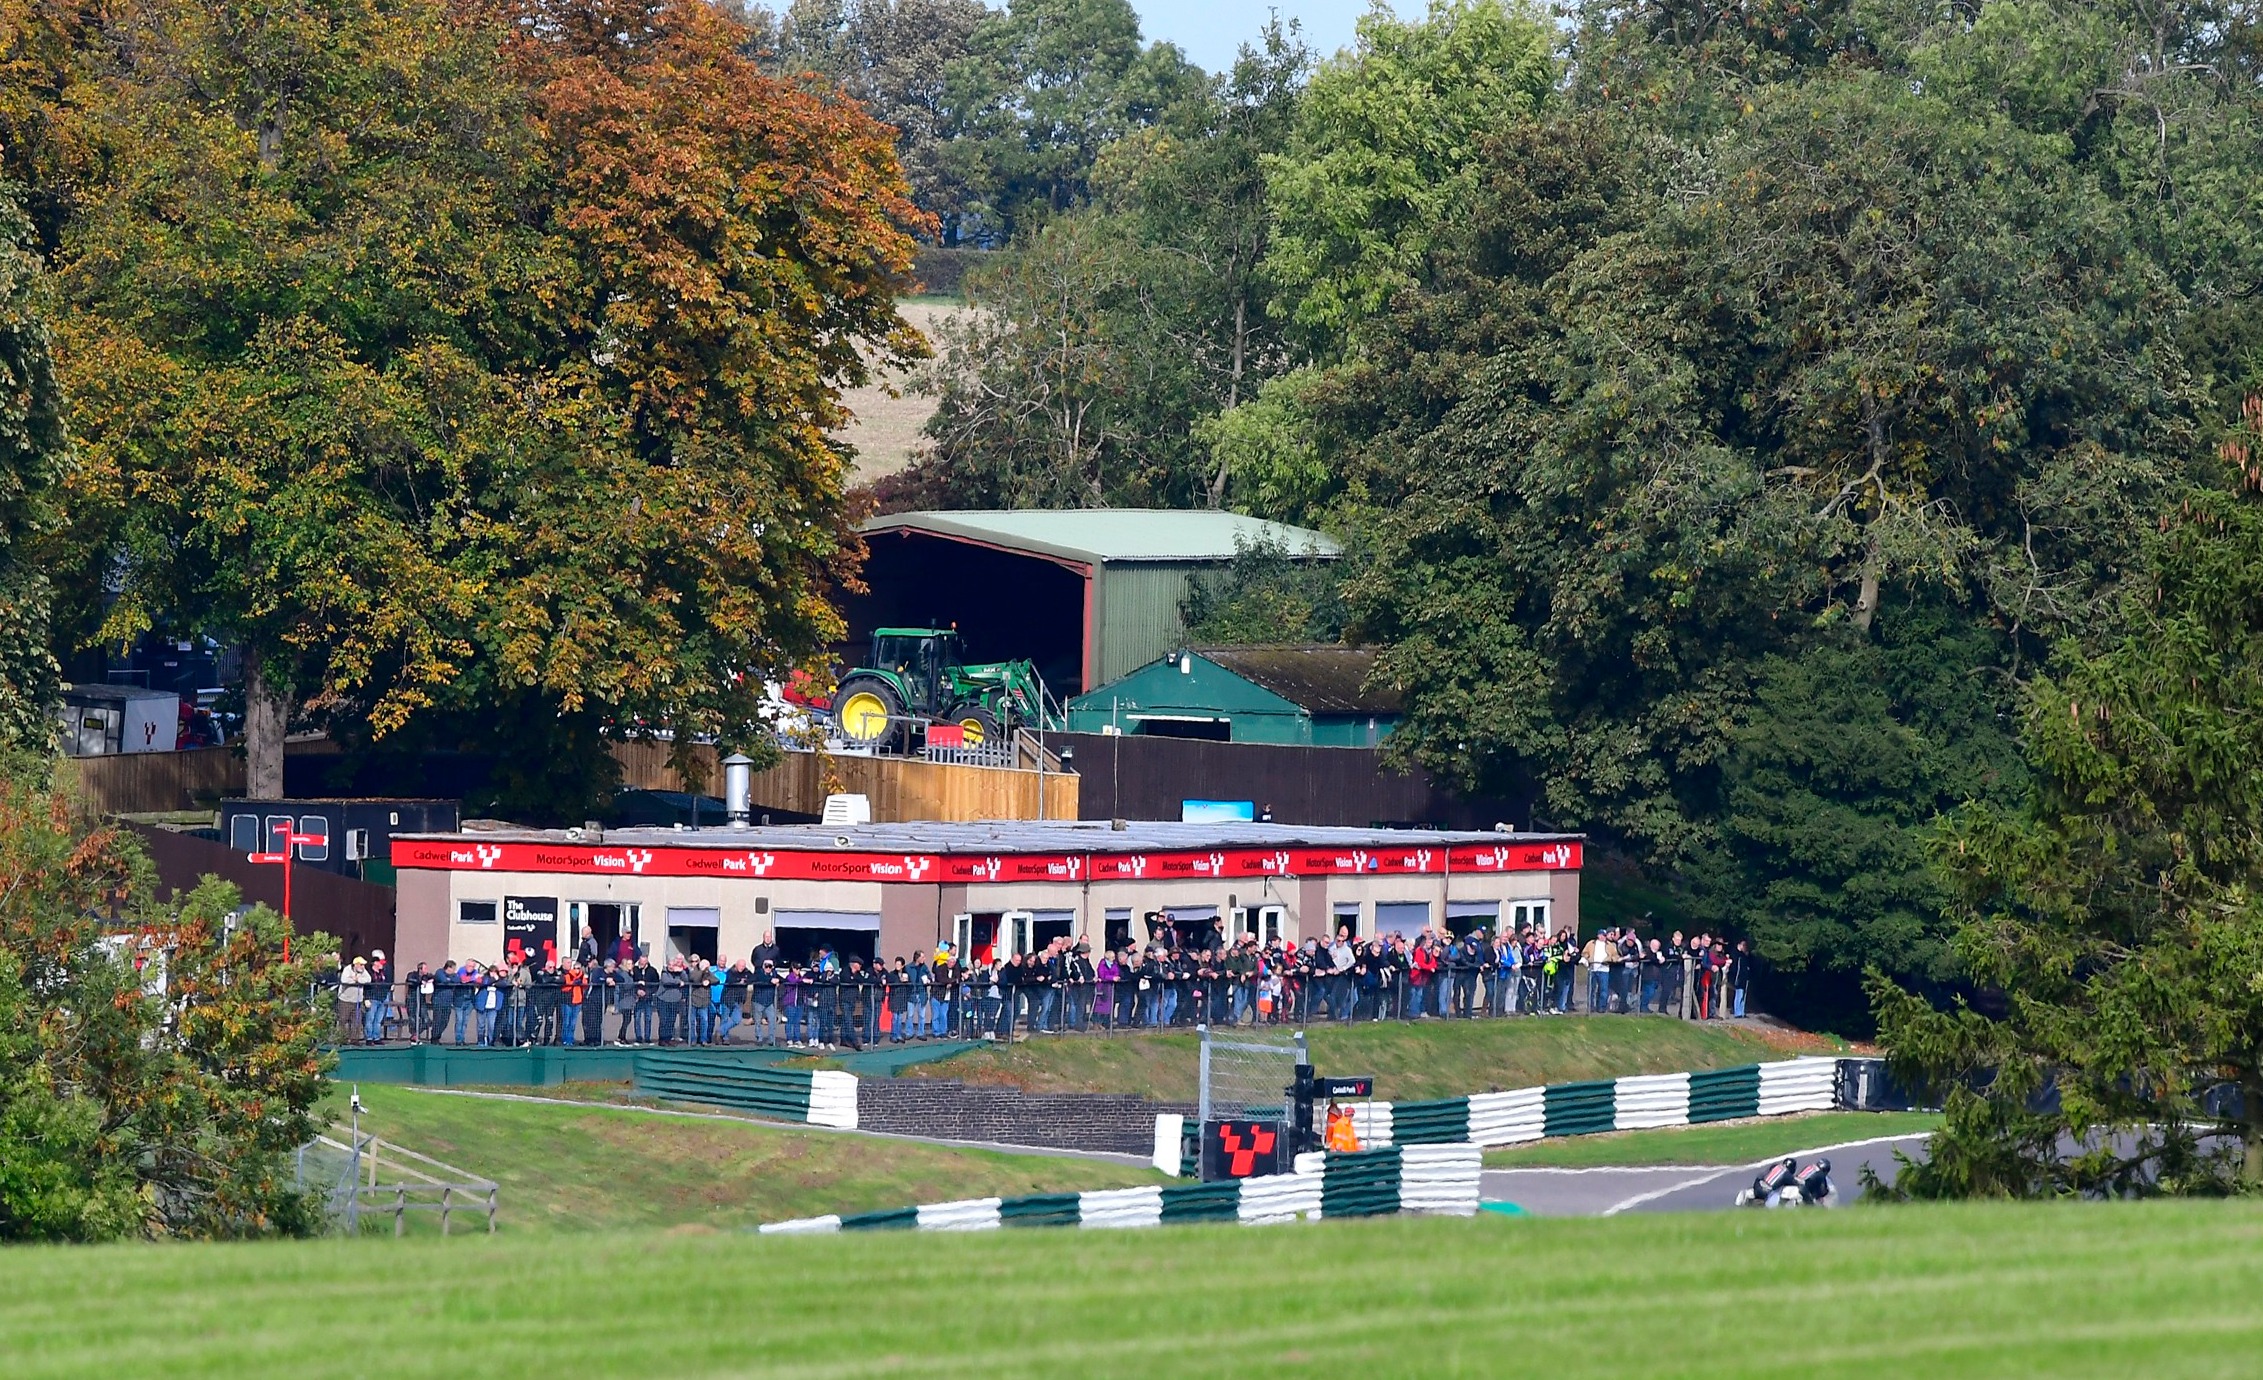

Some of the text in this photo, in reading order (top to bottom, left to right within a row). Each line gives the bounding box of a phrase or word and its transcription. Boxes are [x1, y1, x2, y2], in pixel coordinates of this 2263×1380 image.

[536, 853, 626, 868] MotorSportVision
[811, 861, 903, 875] MotorSportVision
[507, 900, 524, 910] The
[506, 910, 553, 921] Clubhouse
